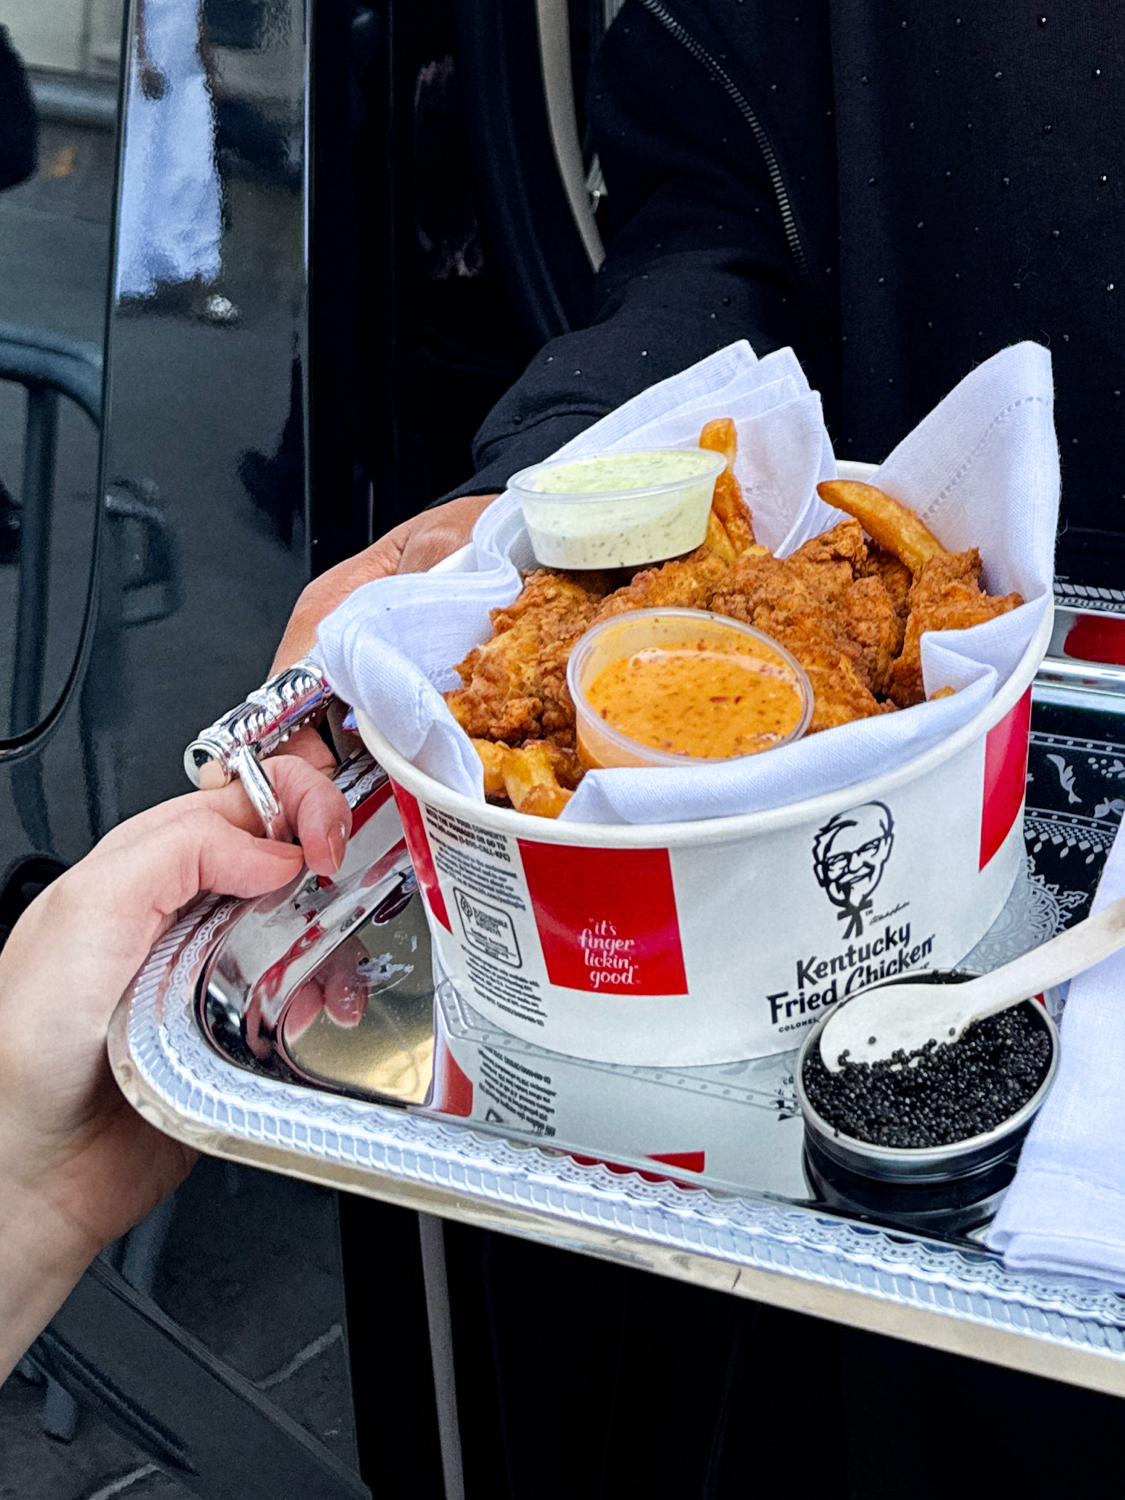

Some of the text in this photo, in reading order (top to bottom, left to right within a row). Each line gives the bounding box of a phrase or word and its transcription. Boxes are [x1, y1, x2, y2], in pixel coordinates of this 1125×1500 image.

[579, 928, 635, 957] finger
[796, 921, 911, 990] Kentucky
[766, 937, 932, 1025] Fried Chicken
